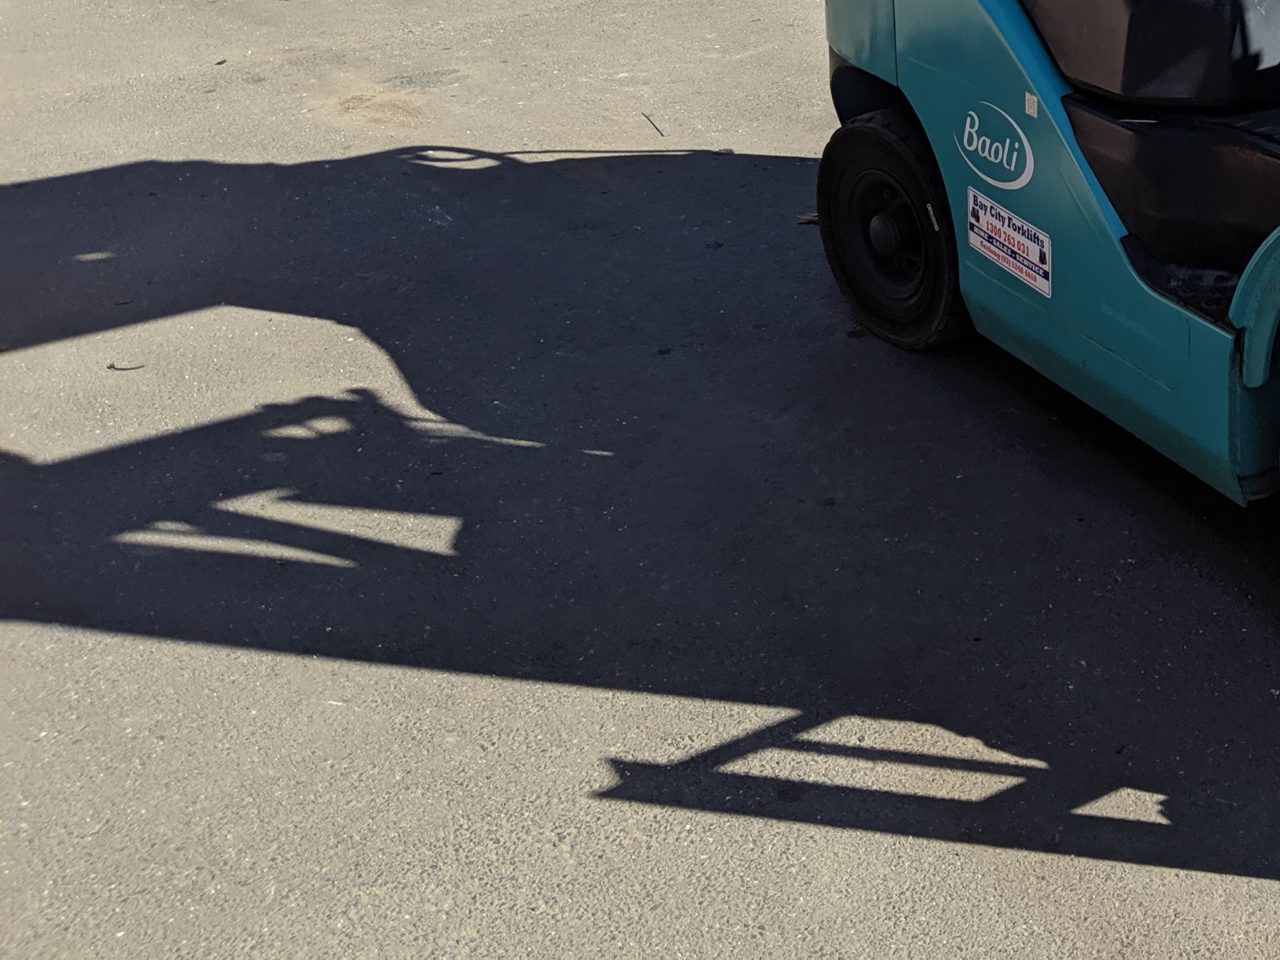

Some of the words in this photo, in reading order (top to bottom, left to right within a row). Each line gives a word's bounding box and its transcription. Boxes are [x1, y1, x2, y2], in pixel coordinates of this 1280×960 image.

[963, 110, 1020, 172] Baoli
[972, 194, 988, 216] Bay
[989, 205, 1006, 227] City
[1007, 216, 1045, 249] Forklifts
[986, 220, 1002, 239] 1300
[1003, 230, 1016, 248] 763
[1017, 240, 1029, 257] 031
[1016, 256, 1045, 277] SERVICE
